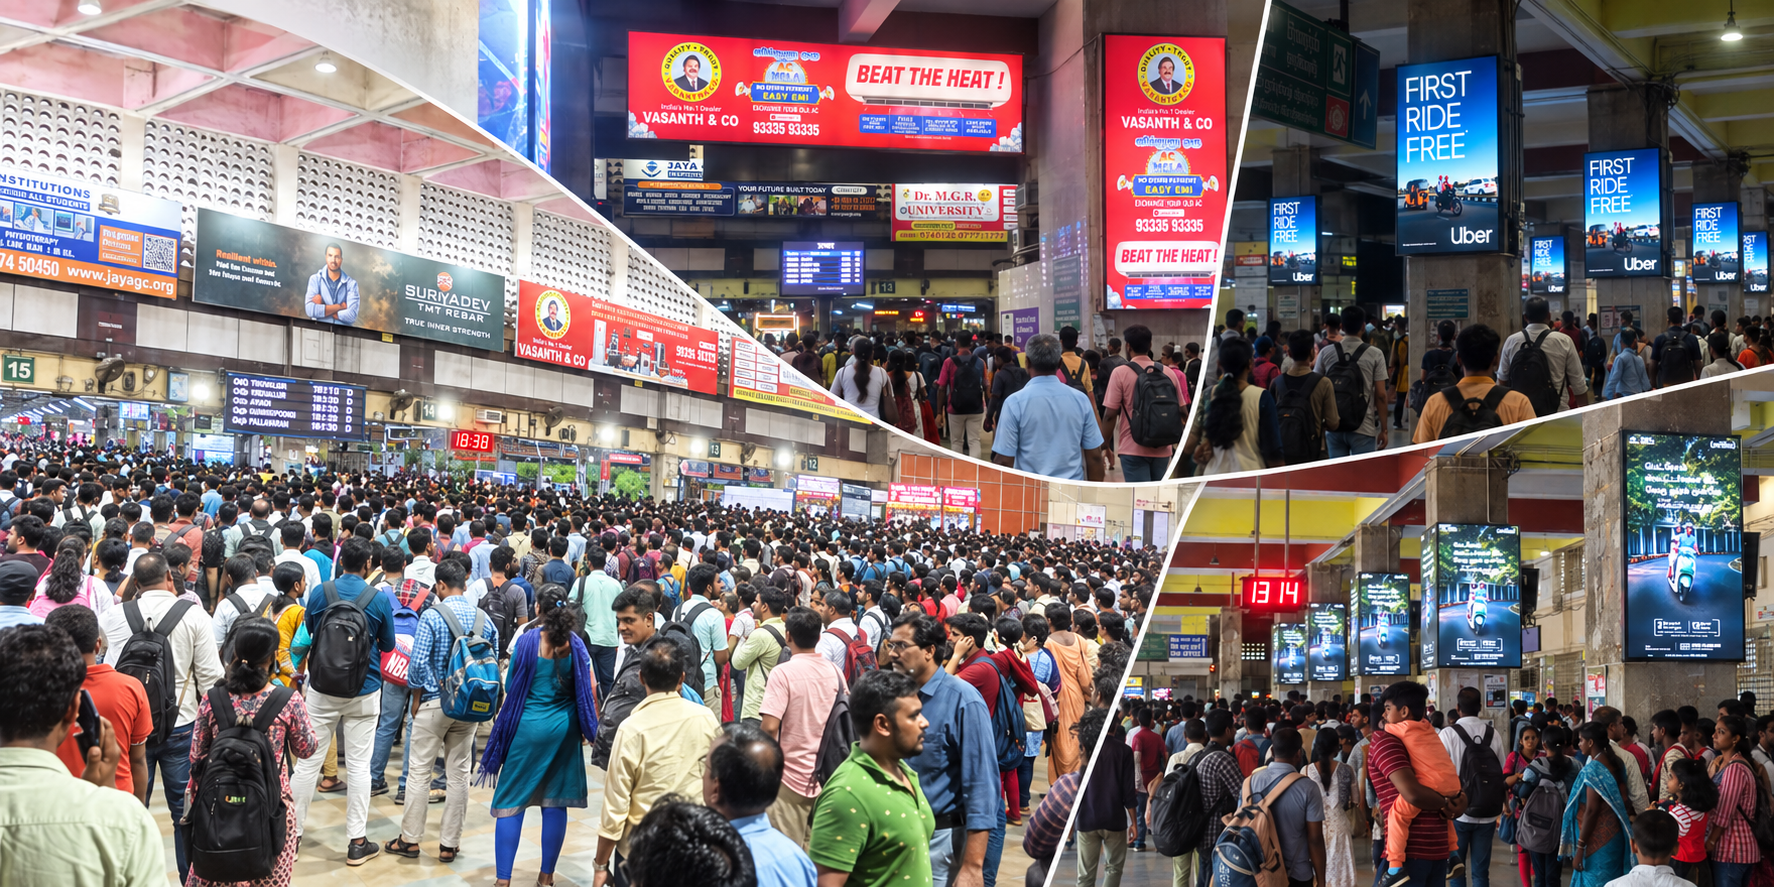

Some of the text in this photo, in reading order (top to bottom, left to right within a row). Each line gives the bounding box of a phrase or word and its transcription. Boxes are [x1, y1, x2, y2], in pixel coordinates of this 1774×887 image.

[777, 62, 793, 72] AC
[856, 65, 905, 84] BEAT
[909, 67, 944, 86] THE
[946, 69, 994, 89] HEAT
[1405, 70, 1472, 103] FIRST
[643, 112, 739, 126] VASANTH & CO
[1121, 116, 1212, 130] VASANTH & CO
[1406, 102, 1461, 133] RIDE
[753, 122, 820, 136] 93335 93335
[1406, 132, 1465, 163] FREE
[1159, 152, 1175, 161] AC
[668, 162, 698, 170] JAYA
[1590, 157, 1635, 176] FIRST
[0, 174, 90, 199] NSTITUTIONS
[1590, 176, 1628, 195] RIDE
[914, 191, 976, 202] Dr. M.G.R.
[908, 206, 984, 216] UNIVERSITY
[1274, 202, 1300, 215] FIRST
[1591, 195, 1631, 214] FREE
[1695, 207, 1723, 219] FIRST
[1136, 219, 1203, 232] 93335 93335
[1274, 216, 1296, 229] RIDE
[1696, 219, 1718, 231] RIDE
[1274, 229, 1299, 243] FREE
[1450, 226, 1493, 244] Uber
[1696, 231, 1722, 244] FREE
[1121, 249, 1153, 263] BEAT
[1156, 249, 1179, 263] THE
[1181, 249, 1212, 263] HEAT
[18, 256, 59, 276] 50450
[1624, 257, 1657, 271] Uber
[67, 266, 174, 295] www.jayagc.org
[1293, 272, 1314, 281] Uber
[1715, 271, 1736, 280] Uber
[881, 283, 893, 292] 13
[405, 284, 490, 311] SURIYADEV
[418, 303, 484, 323] TMT REBAR
[404, 317, 491, 339] TRUE INNER STRENGTH
[519, 343, 562, 362] VASANTH
[564, 352, 571, 364] &
[573, 354, 586, 367] CO
[8, 361, 31, 379] 15
[424, 404, 435, 417] 14
[455, 433, 490, 449] 18:38
[711, 444, 720, 456] 13
[808, 458, 818, 470] 12
